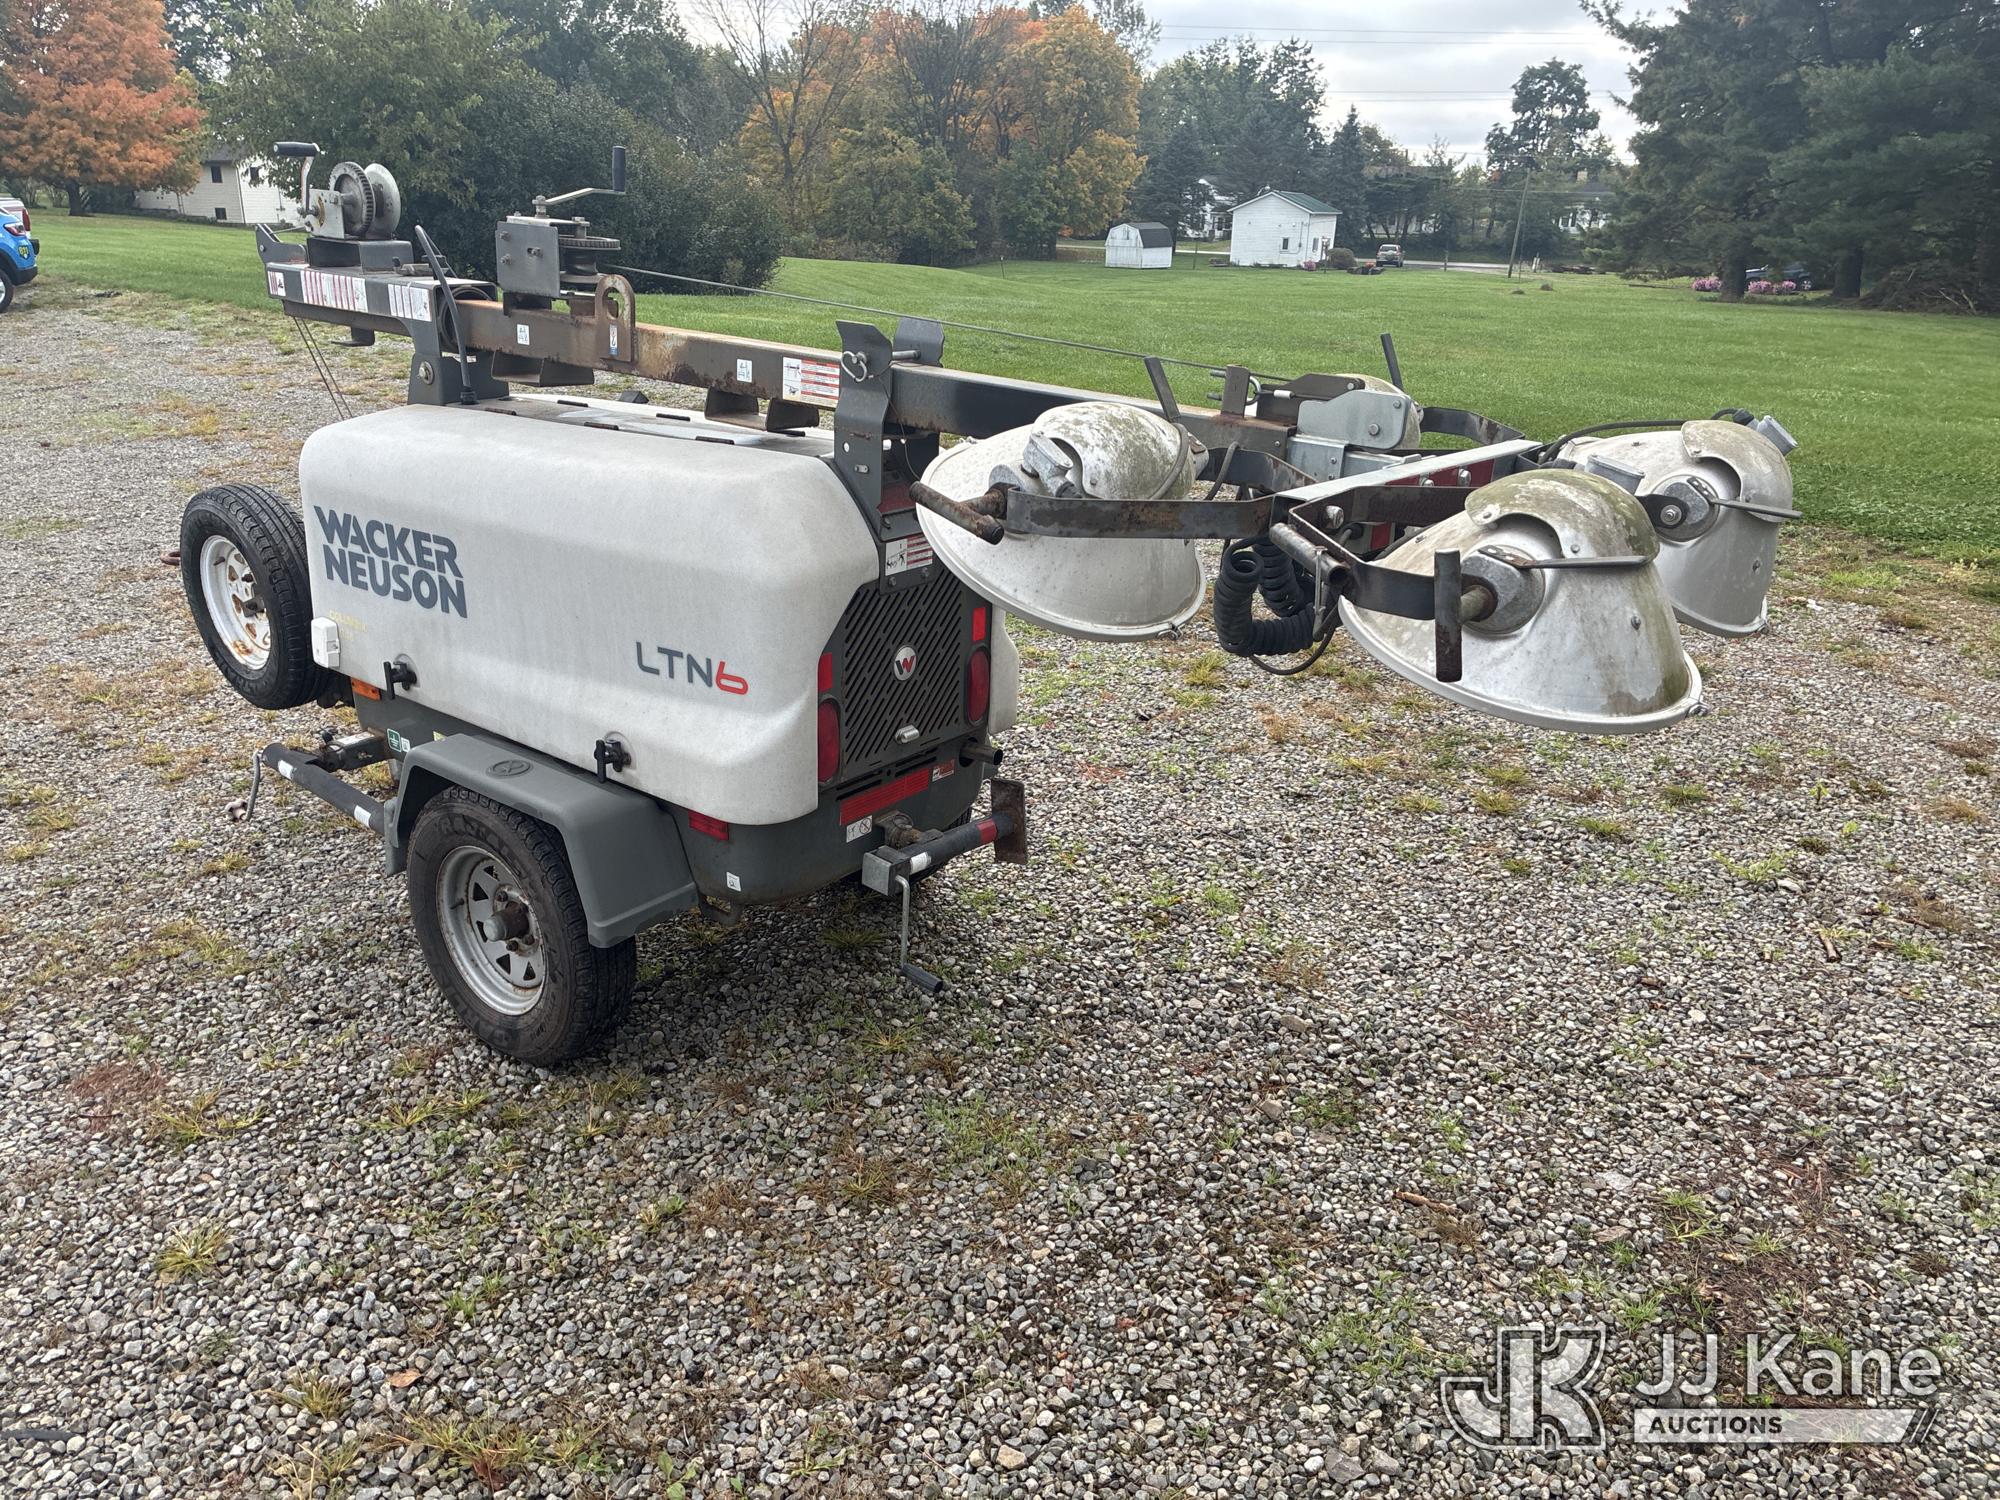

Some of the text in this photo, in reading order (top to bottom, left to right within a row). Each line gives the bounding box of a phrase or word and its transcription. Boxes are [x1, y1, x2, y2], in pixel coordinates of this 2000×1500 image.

[313, 505, 464, 578] WACKER
[322, 544, 468, 618] NEUSON
[636, 641, 749, 695] LTN6
